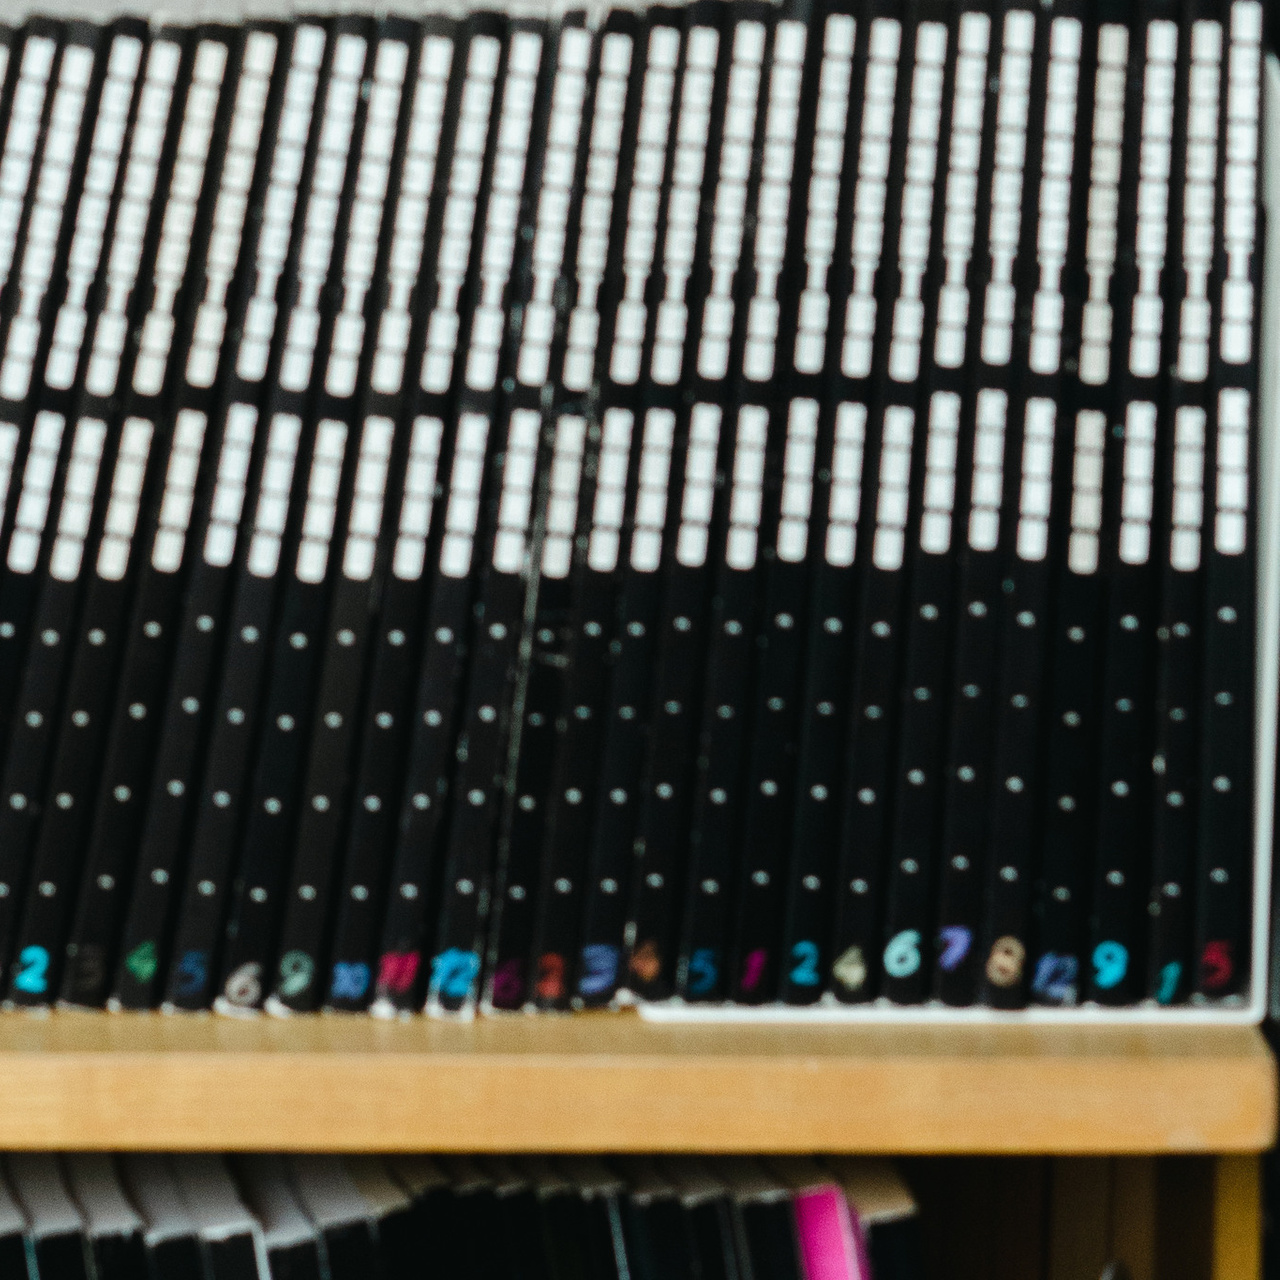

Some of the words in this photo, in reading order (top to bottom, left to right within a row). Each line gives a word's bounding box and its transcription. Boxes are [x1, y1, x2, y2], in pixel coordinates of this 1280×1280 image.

[15, 945, 50, 994] 2
[789, 939, 820, 987] 2
[883, 928, 921, 979] 6
[938, 925, 973, 971] 7
[986, 935, 1026, 987] 8
[1092, 940, 1129, 989] 9
[225, 961, 262, 1007] 6
[280, 950, 315, 996] 9
